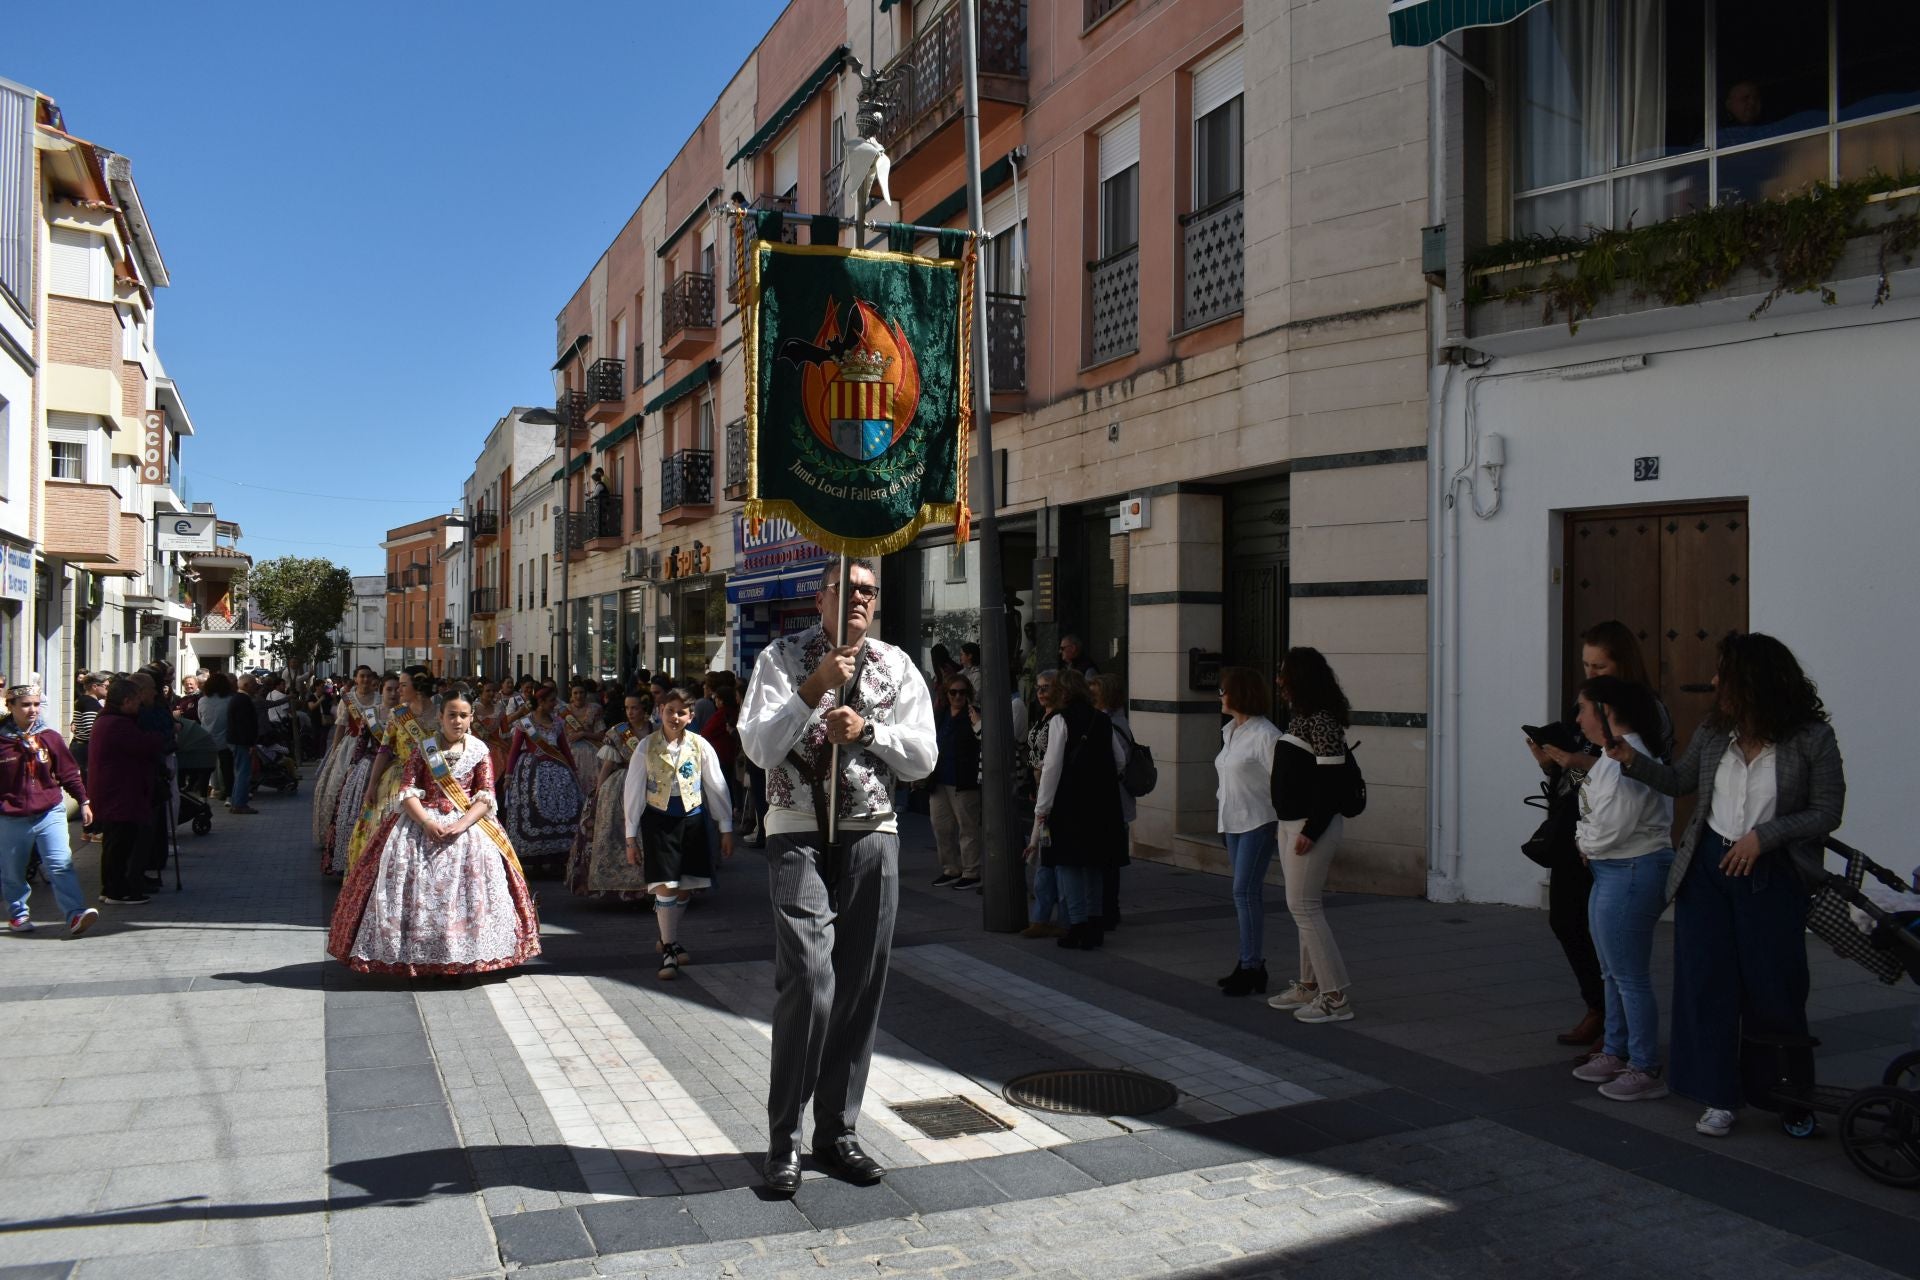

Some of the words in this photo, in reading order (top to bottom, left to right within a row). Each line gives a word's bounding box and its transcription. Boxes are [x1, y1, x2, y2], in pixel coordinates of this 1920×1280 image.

[788, 458, 817, 486] Junta
[817, 478, 848, 499] Local
[851, 486, 888, 501] Fallera
[889, 483, 901, 494] de
[901, 461, 927, 488] Puçol
[1635, 458, 1658, 479] 32
